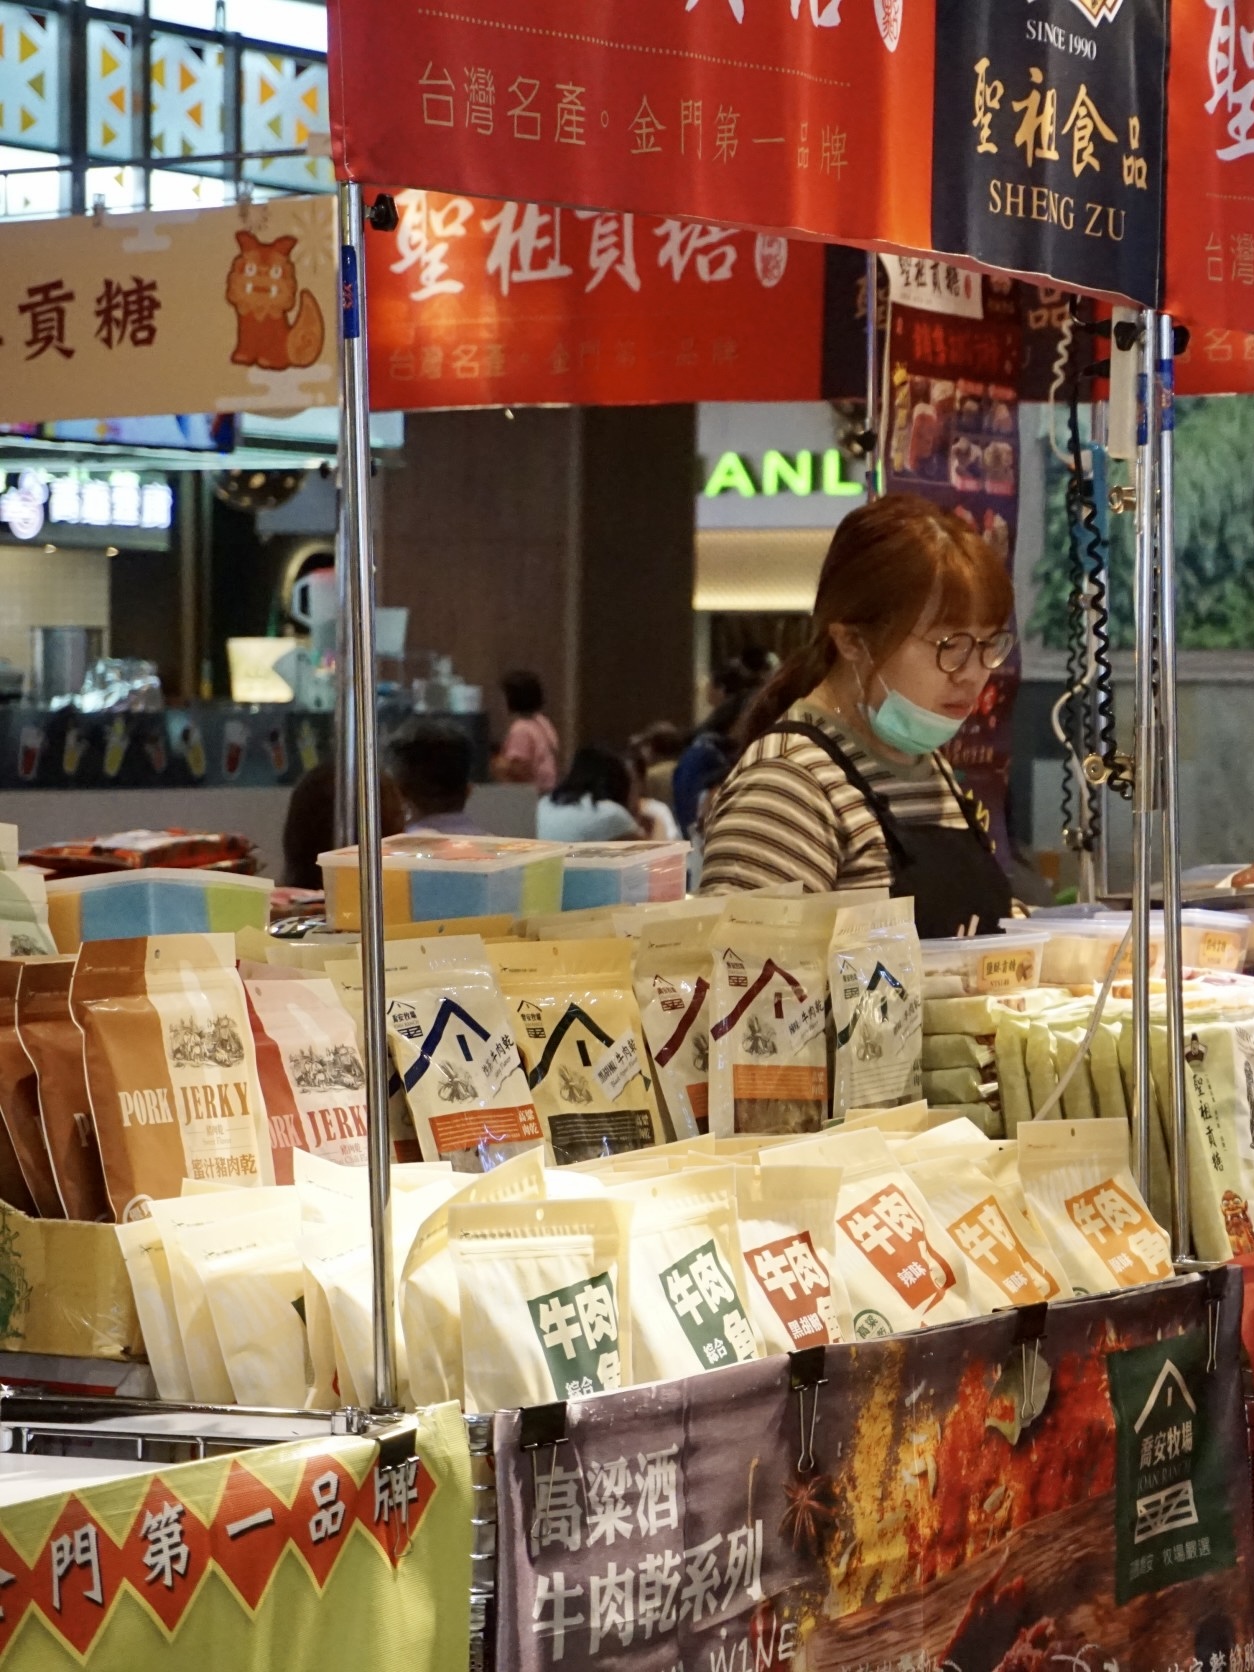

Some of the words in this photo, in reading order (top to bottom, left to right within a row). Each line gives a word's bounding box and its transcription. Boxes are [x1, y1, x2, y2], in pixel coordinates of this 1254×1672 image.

[1025, 19, 1066, 51] SINCE
[1069, 32, 1097, 60] 1990
[972, 56, 1149, 191] 聖祖食品
[989, 180, 1075, 231] SHENG
[1084, 199, 1127, 242] ZU
[118, 1088, 174, 1127] PORK
[180, 1082, 250, 1126] JERKY
[307, 1104, 367, 1148] JERK
[191, 1153, 257, 1180] 蜜汁豬肉乾
[846, 1191, 924, 1256] 牛肉
[1072, 1188, 1142, 1243] 牛肉
[666, 1252, 735, 1325] 牛肉
[754, 1240, 830, 1300] 牛肉
[896, 1261, 928, 1288] 辣味
[539, 1284, 618, 1360] 牛肉
[787, 1313, 823, 1339] 黑胡椒
[702, 1338, 727, 1364] 綜合
[565, 1376, 594, 1399] 綜合
[0, 1466, 419, 1616] 門第一品牌
[532, 1519, 763, 1661] 牛肉乾系列
